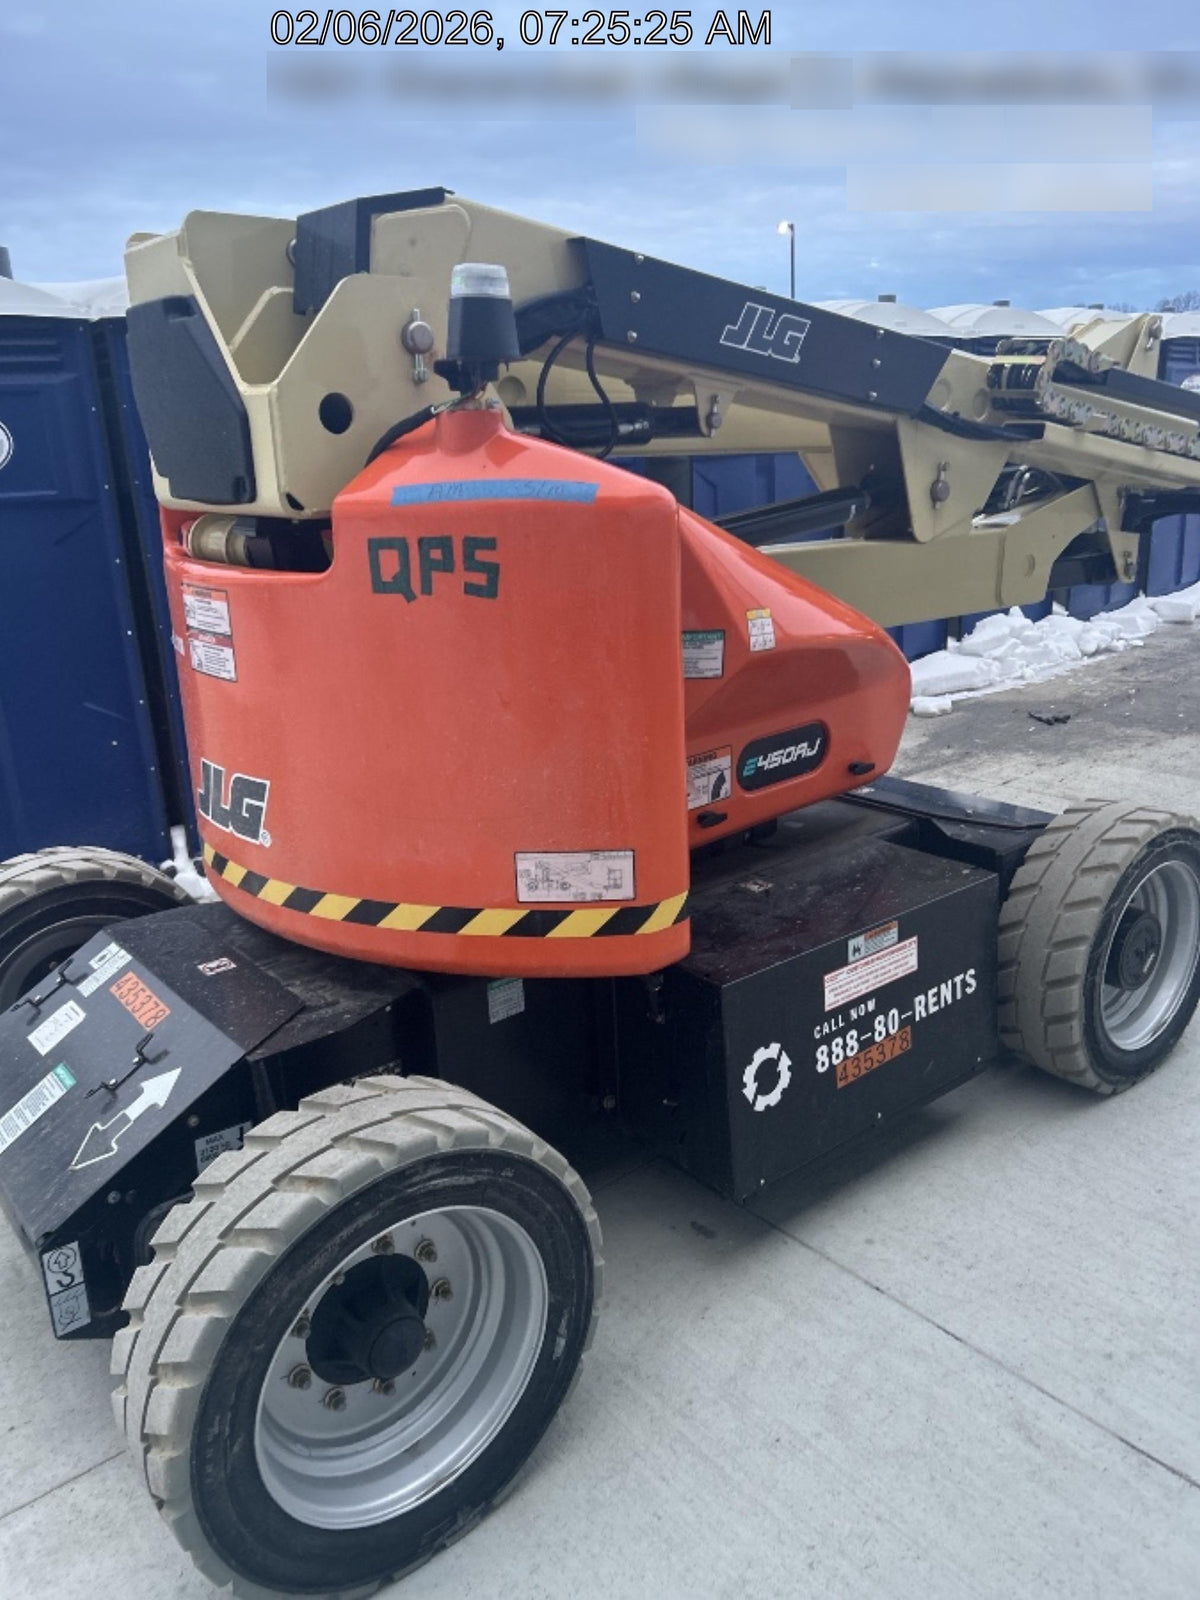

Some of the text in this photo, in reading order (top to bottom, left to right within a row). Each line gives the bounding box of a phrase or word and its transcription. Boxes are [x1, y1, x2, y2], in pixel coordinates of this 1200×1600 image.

[719, 301, 812, 364] JLG
[367, 535, 501, 604] QPS
[114, 974, 168, 1030] 435378
[813, 997, 876, 1040] CALL NOW
[815, 967, 978, 1074] 888-80-RENTS
[838, 1029, 910, 1084] 435378
